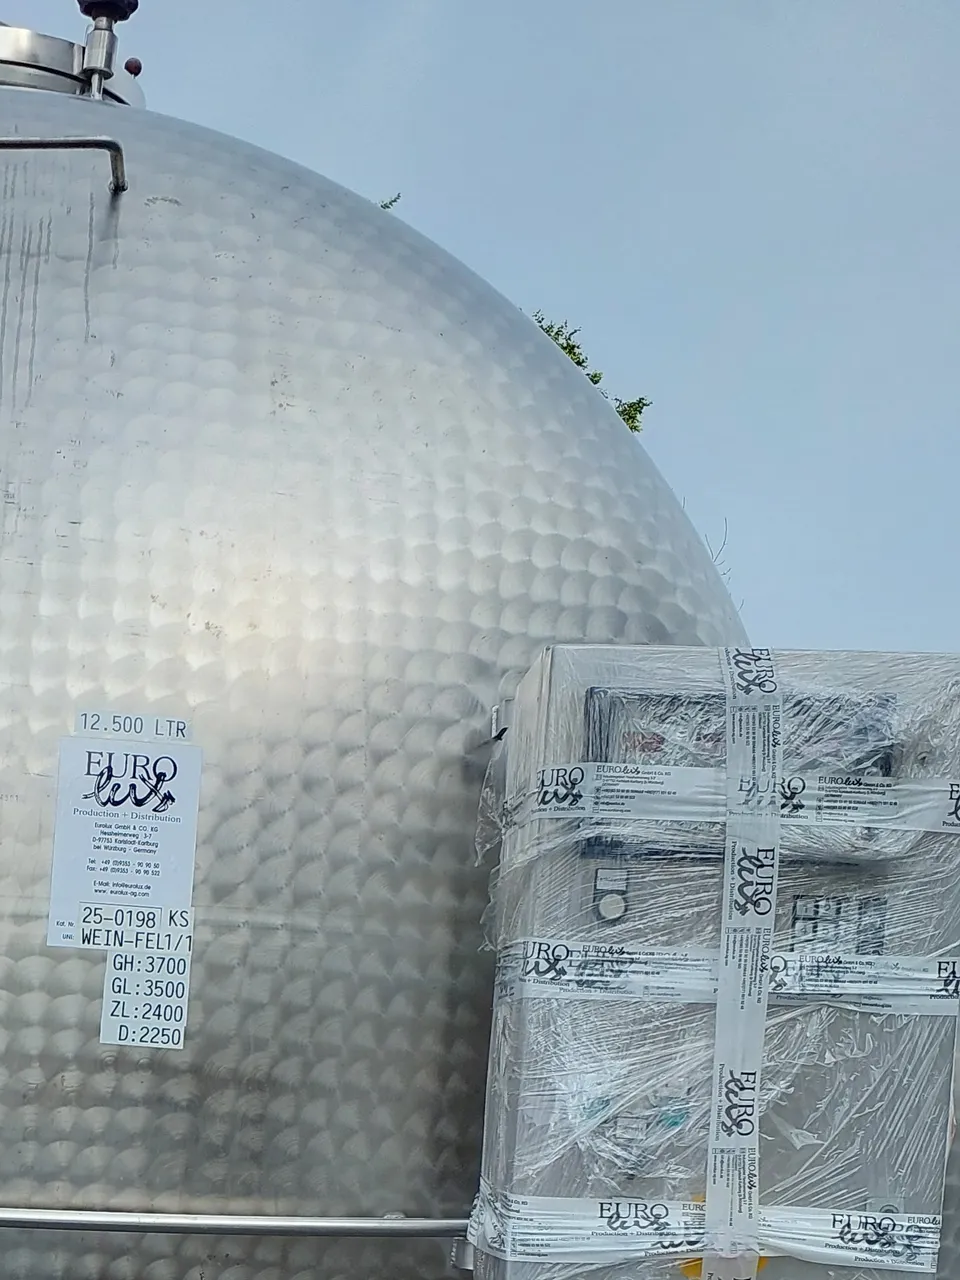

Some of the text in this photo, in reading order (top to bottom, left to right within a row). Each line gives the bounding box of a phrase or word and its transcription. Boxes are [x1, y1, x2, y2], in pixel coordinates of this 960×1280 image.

[751, 648, 778, 694] EURO
[80, 712, 187, 738] 12.500 LTR
[83, 750, 178, 783] EURO
[538, 766, 585, 787] URO
[82, 766, 176, 813] lux
[818, 776, 863, 787] EUROlux
[73, 807, 120, 819] Production
[130, 811, 182, 823] Distribution
[114, 823, 131, 831] GmbH
[103, 844, 127, 853] Würzburg
[133, 846, 157, 855] Germany
[729, 841, 737, 876] Production
[753, 847, 775, 916] EURO
[728, 882, 736, 921] Distribution
[82, 906, 156, 929] 25-0198
[168, 909, 189, 928] KS
[81, 927, 192, 952] WEIN-FEL1/1
[522, 940, 570, 961] URO
[759, 927, 772, 973] EUROlux
[113, 953, 187, 976] GH:3700
[111, 976, 185, 999] GL:3500
[110, 1000, 184, 1023] ZL:2400
[118, 1024, 182, 1046] D:2250
[717, 1063, 726, 1098] Production
[735, 1071, 757, 1137] EURO
[747, 1147, 757, 1190] EUROlux
[598, 1201, 669, 1220] EURO
